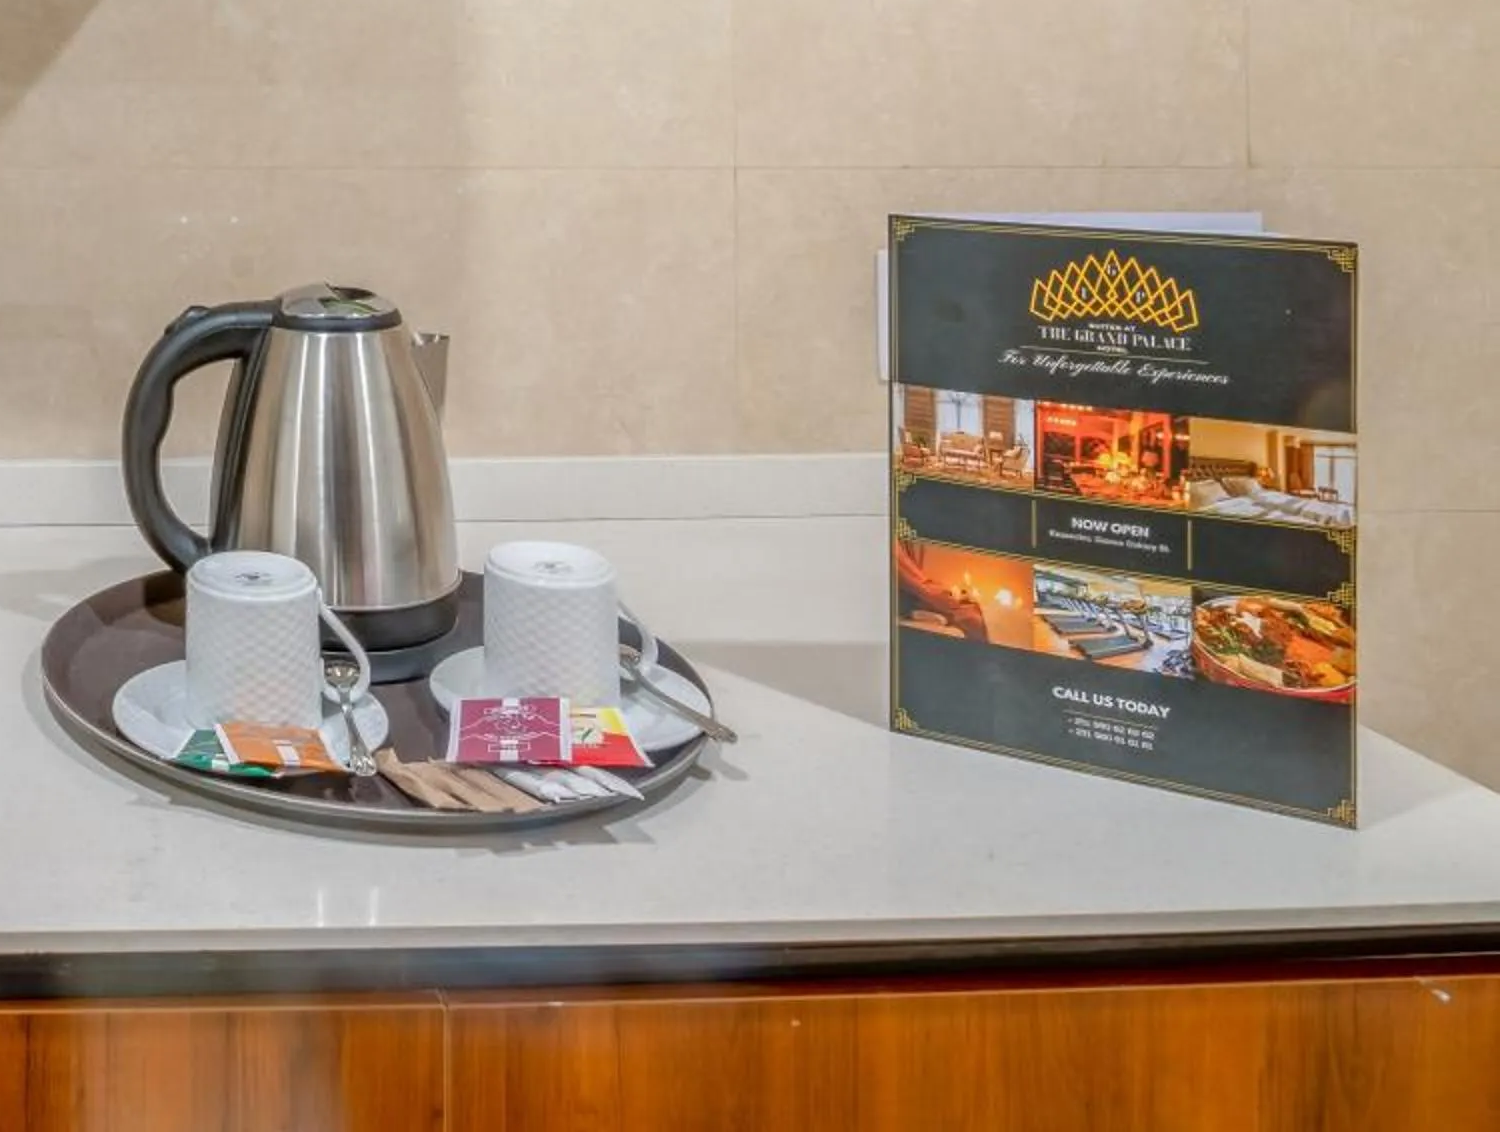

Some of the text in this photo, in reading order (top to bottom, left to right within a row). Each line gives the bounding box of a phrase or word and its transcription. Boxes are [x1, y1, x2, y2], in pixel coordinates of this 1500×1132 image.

[1037, 325, 1193, 352] THE GRAND PALACE
[998, 349, 1231, 385] For Unforgettable Experiences
[1071, 517, 1150, 538] NOW OPEN
[1051, 686, 1171, 718] CALL US TODAY
